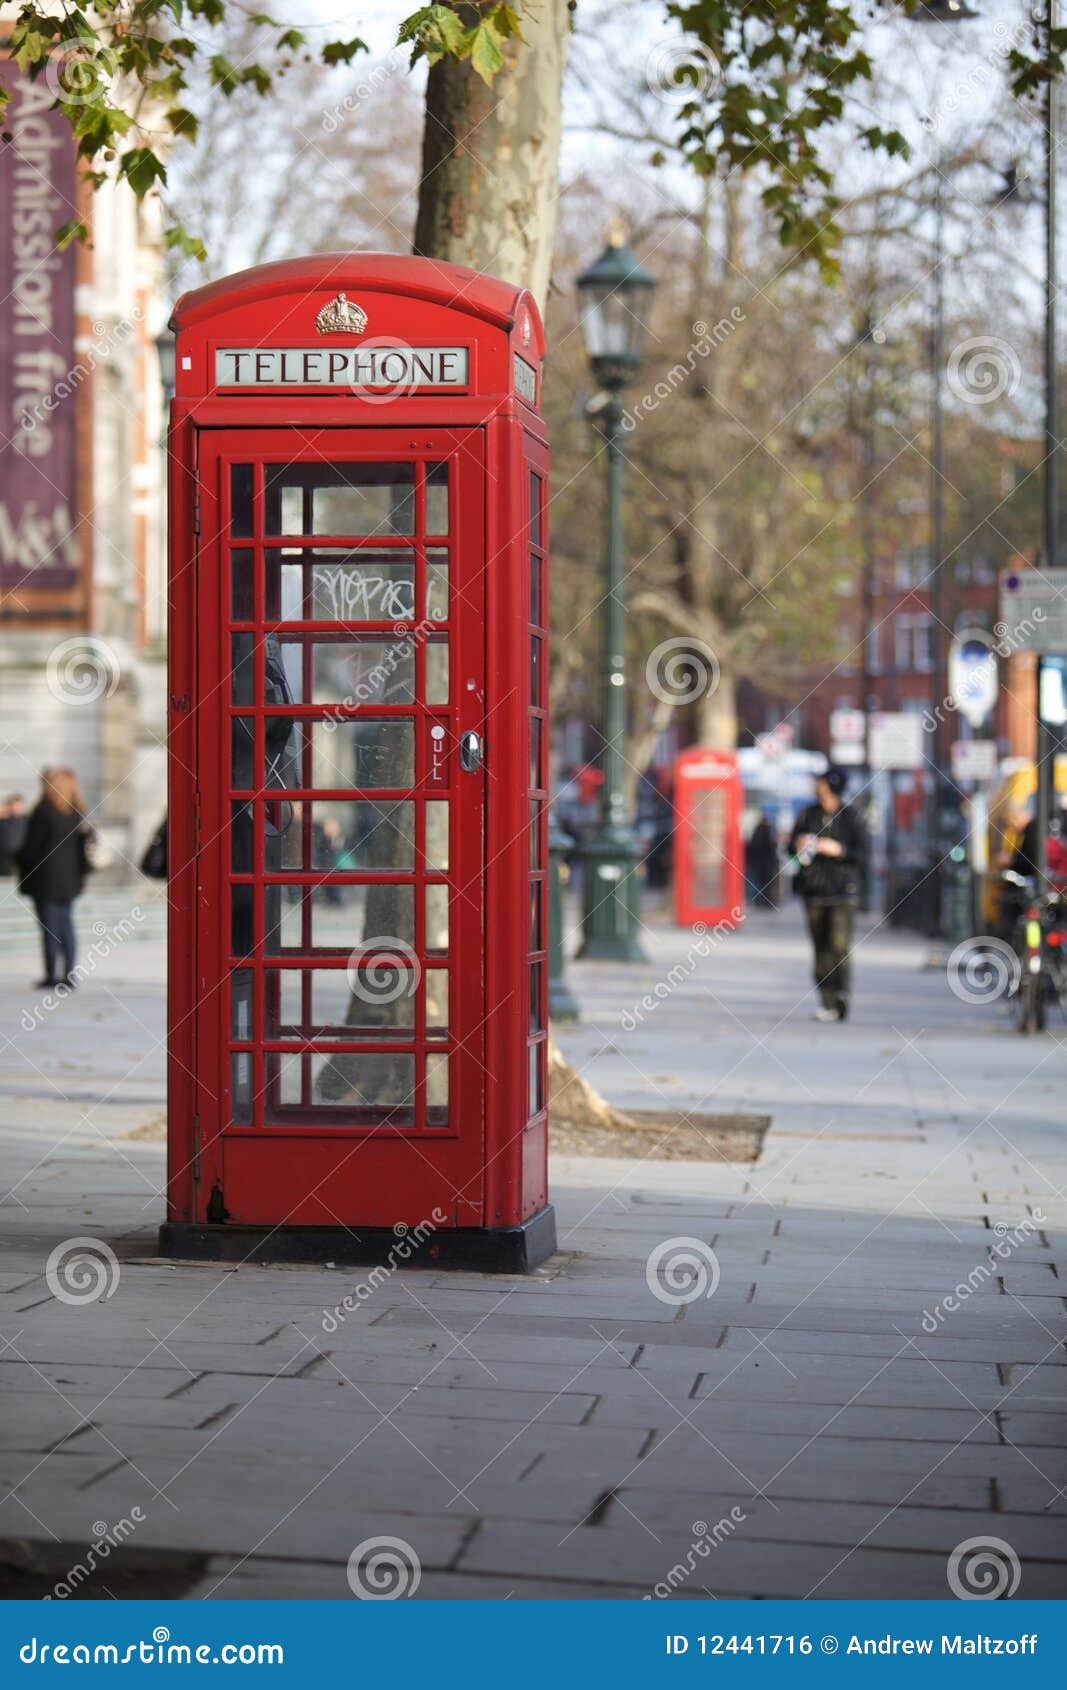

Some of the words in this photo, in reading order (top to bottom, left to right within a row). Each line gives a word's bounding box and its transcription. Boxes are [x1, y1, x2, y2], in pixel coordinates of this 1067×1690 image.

[13, 79, 63, 335] Admission
[13, 350, 66, 457] free
[225, 352, 458, 384] TELEPHONE
